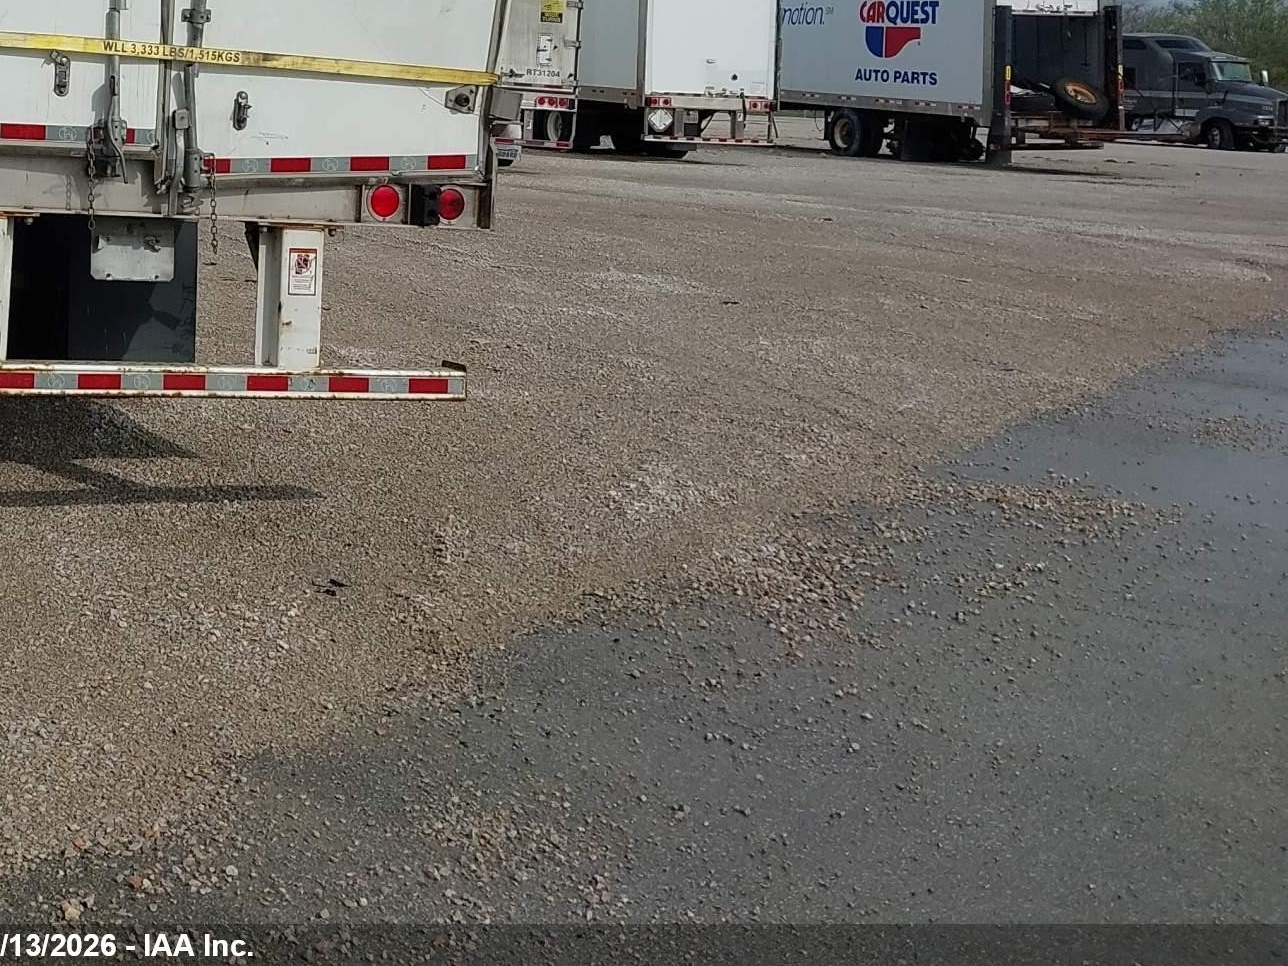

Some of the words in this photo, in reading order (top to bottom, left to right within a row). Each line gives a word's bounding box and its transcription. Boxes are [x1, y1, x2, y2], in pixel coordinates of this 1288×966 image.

[859, 0, 940, 25] CARQUEST
[103, 41, 129, 53] WLL
[131, 43, 160, 56] 3,333
[855, 68, 890, 83] AUTO
[893, 70, 938, 86] PARTS
